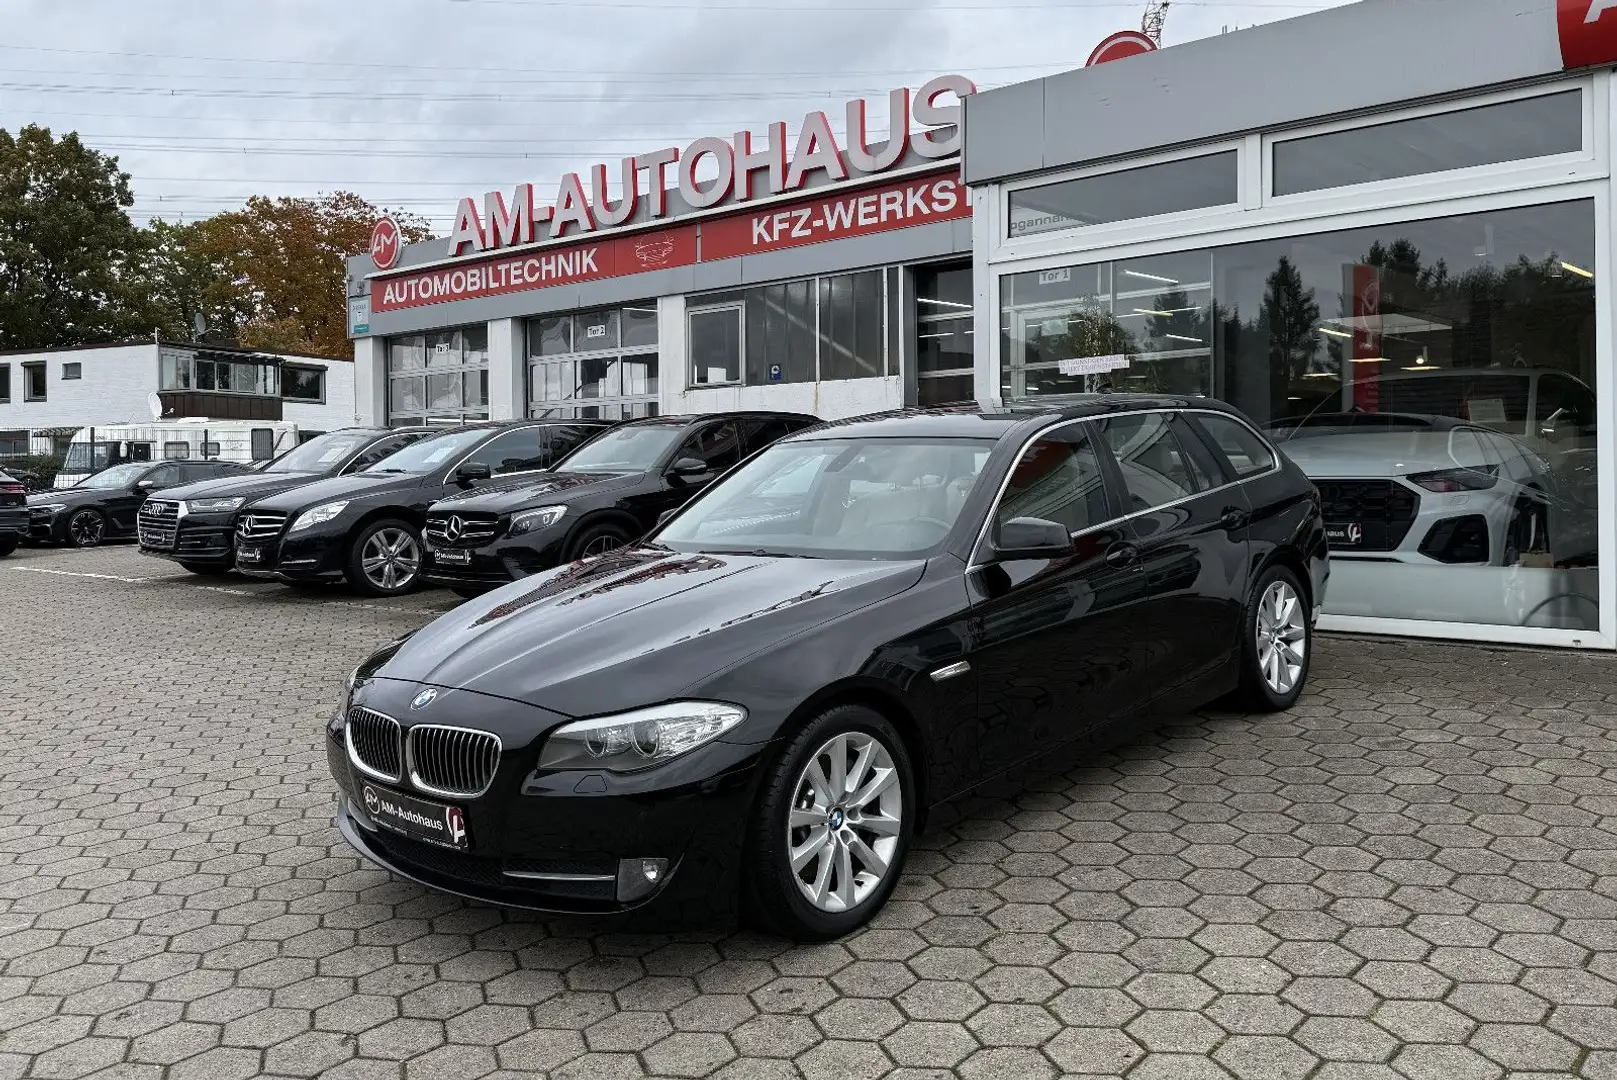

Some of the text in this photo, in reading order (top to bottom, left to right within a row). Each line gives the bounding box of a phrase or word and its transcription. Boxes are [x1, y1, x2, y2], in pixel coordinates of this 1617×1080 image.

[447, 74, 977, 258] AM-AUTOHAUS
[383, 247, 599, 305] AUTOMOBILTECHNIK
[1041, 268, 1069, 281] Tor 1
[588, 328, 600, 336] Tor
[381, 800, 443, 831] AM-Autohaus
